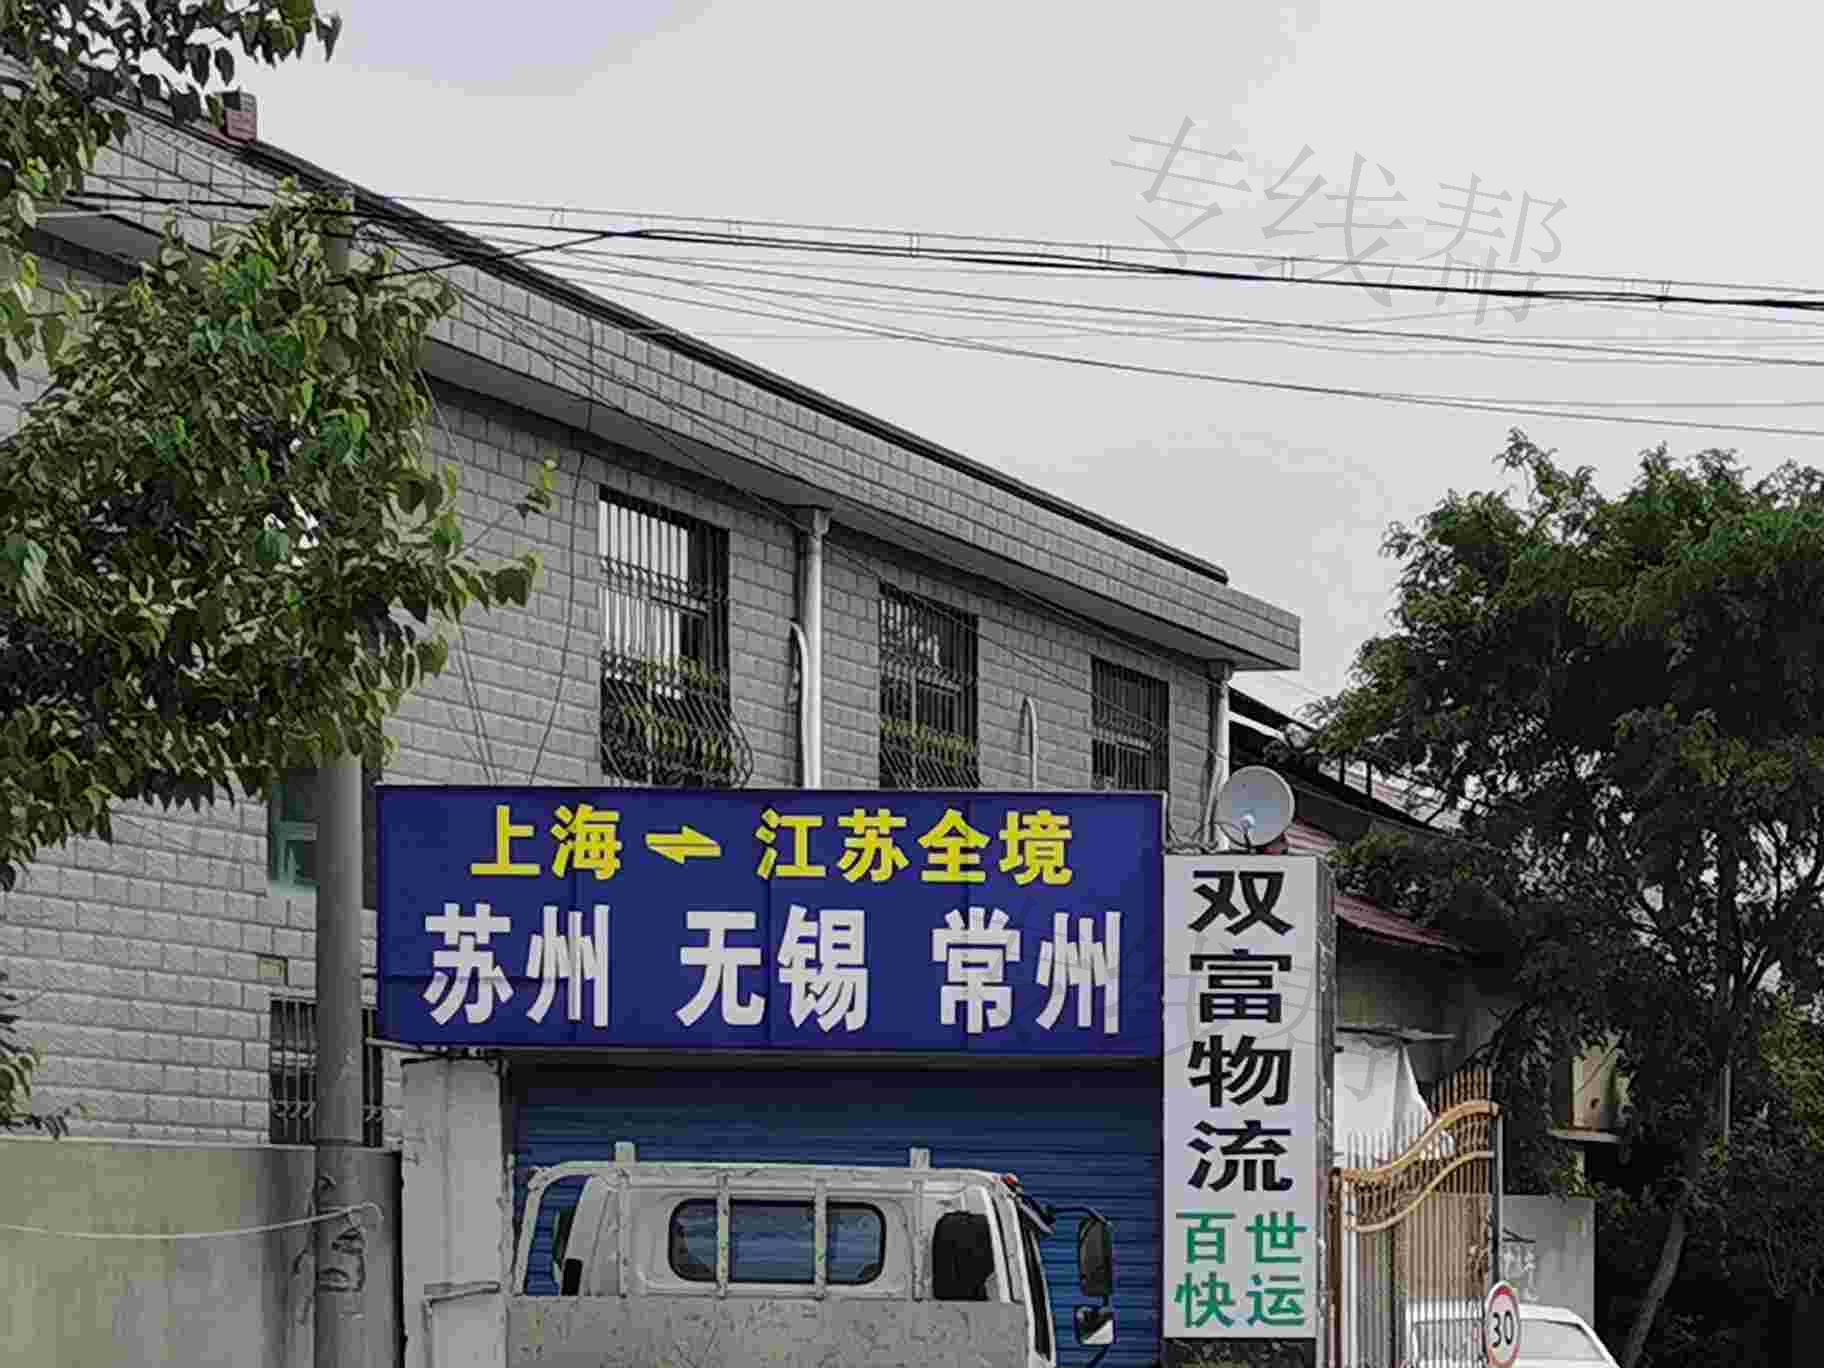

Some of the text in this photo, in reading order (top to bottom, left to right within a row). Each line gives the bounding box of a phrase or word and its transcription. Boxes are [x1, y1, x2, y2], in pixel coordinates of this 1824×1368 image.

[470, 804, 1074, 887] 上海 江苏全境
[423, 902, 1121, 1034] 苏州 无锡 常州
[1187, 868, 1295, 1194] 双富物流
[1175, 1210, 1307, 1265] 百世
[1175, 1272, 1307, 1329] 快运
[1491, 1310, 1515, 1348] 30
